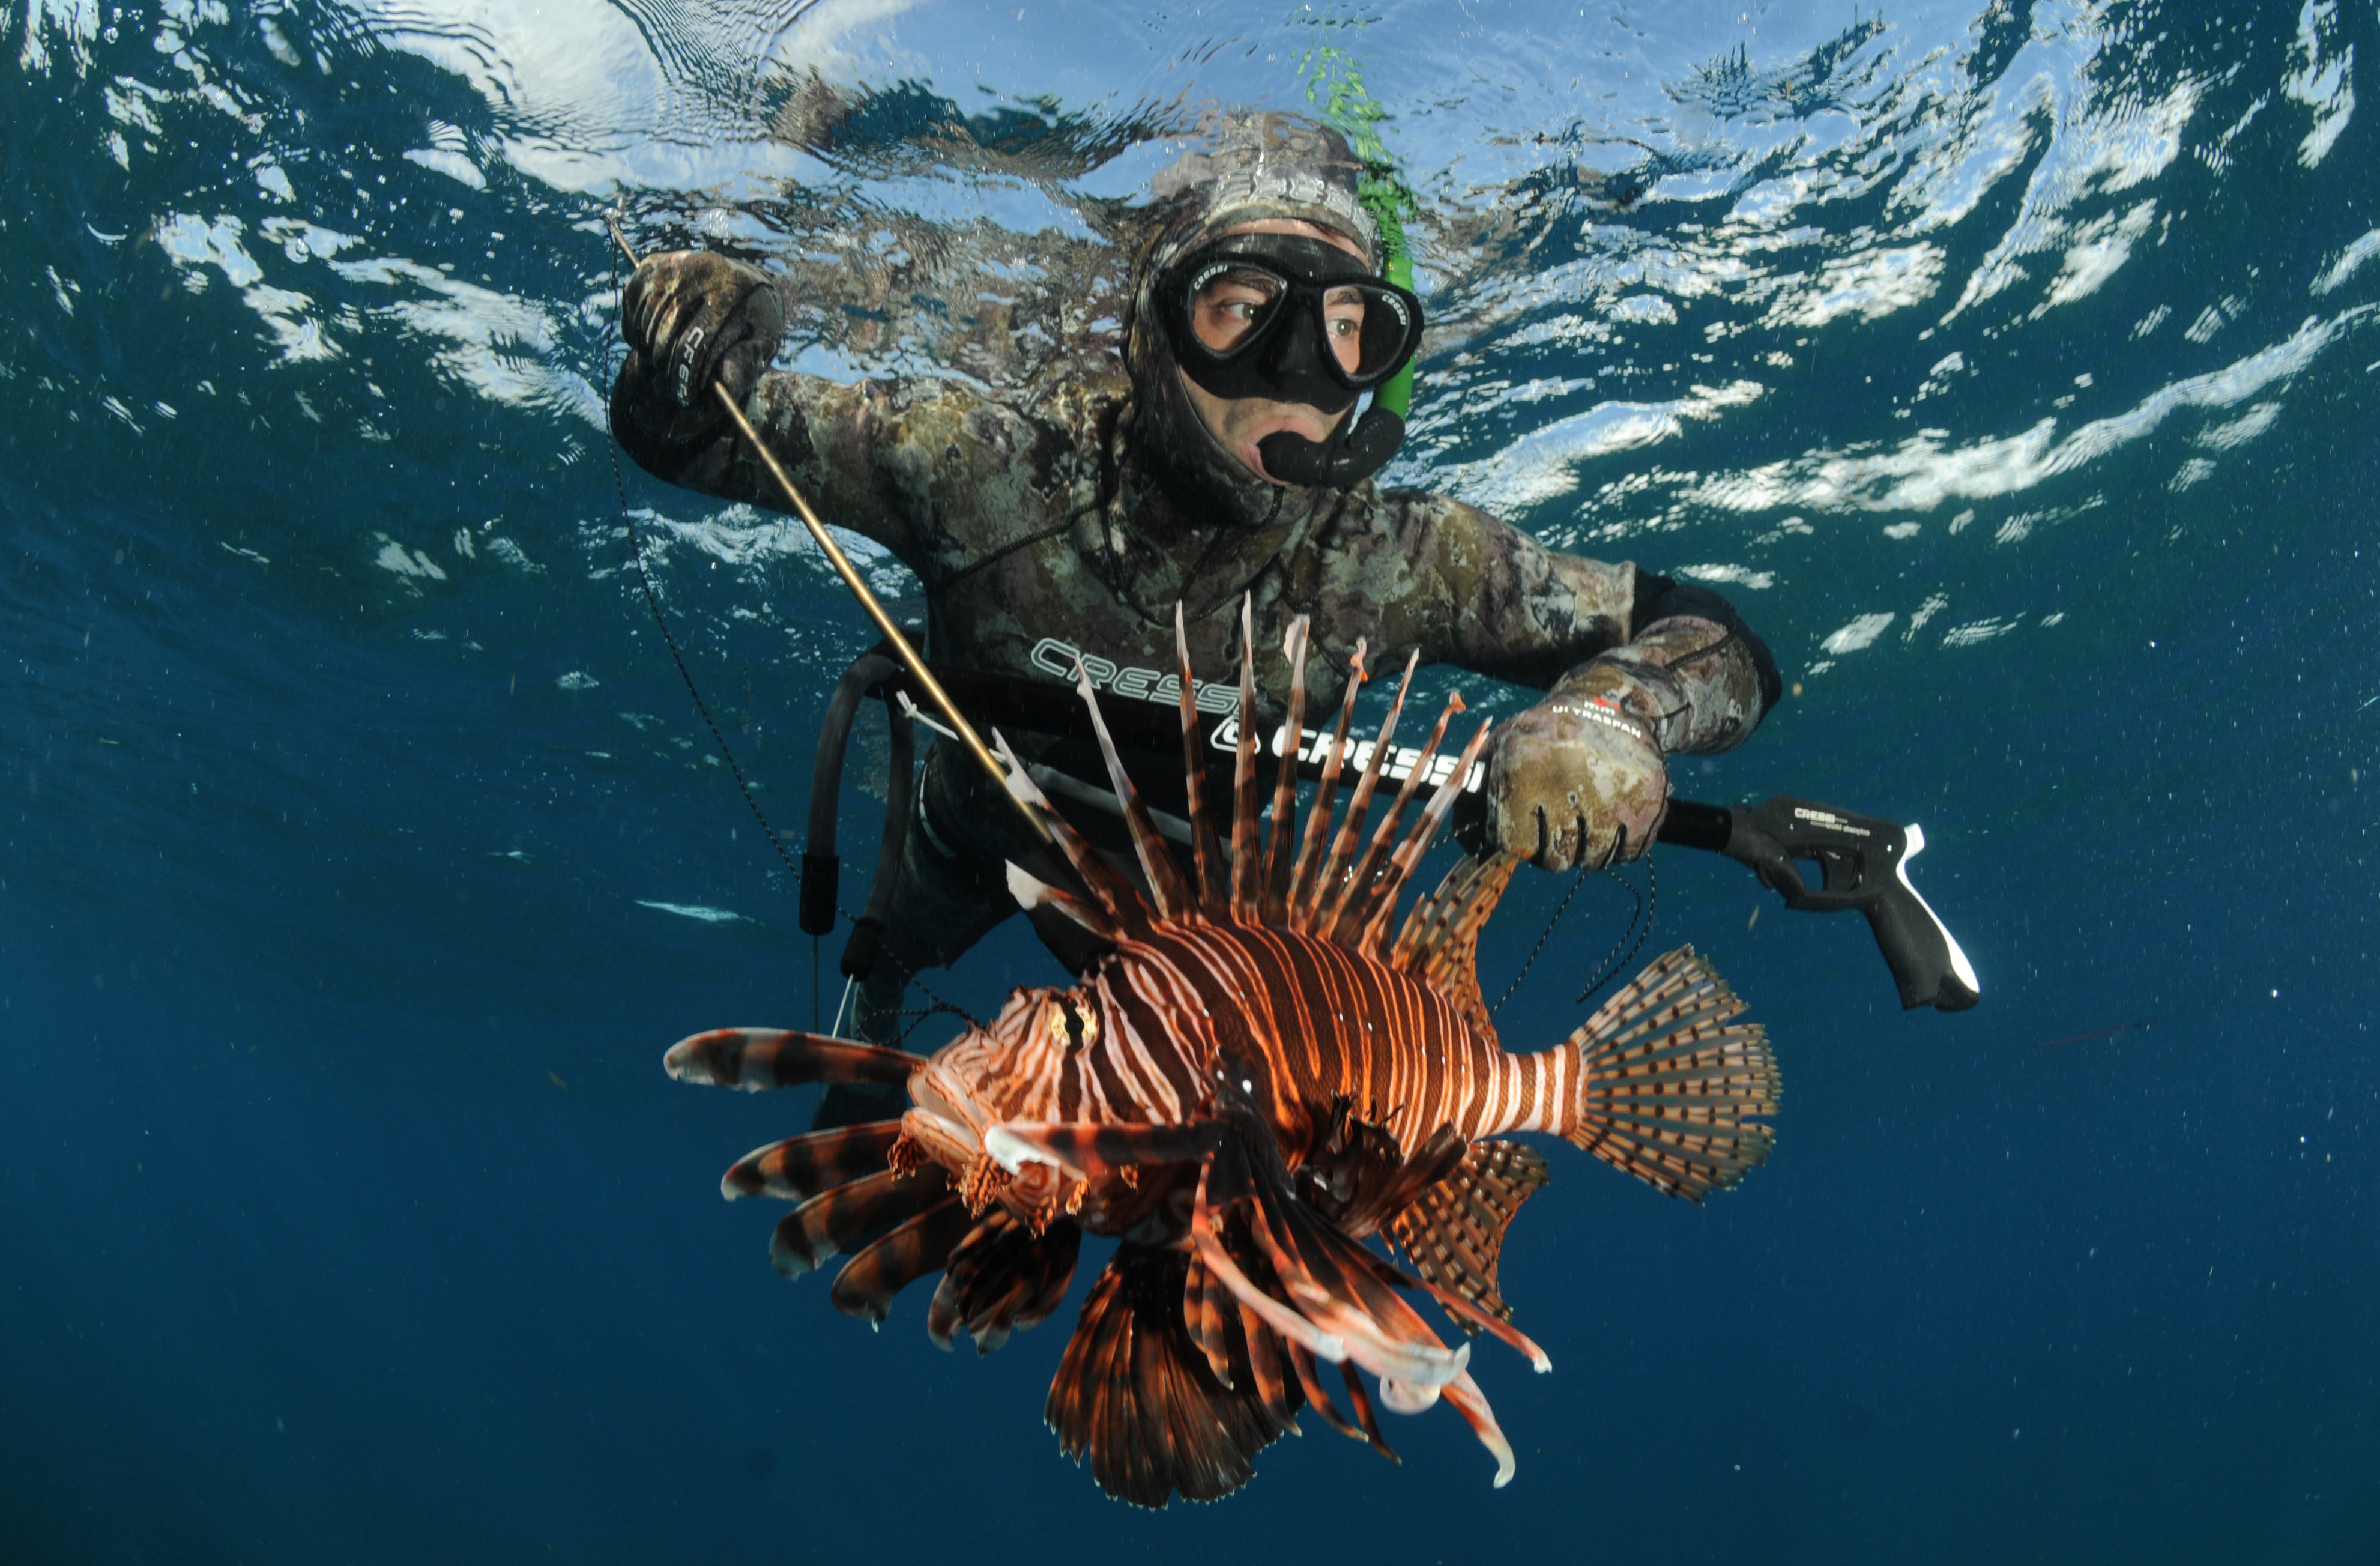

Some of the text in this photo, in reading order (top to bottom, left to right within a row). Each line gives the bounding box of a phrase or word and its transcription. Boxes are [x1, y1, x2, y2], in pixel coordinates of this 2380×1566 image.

[1194, 265, 1228, 291] CRESSI
[1382, 294, 1407, 325] CRESSI
[1031, 638, 1240, 715] CRESS
[1272, 725, 1486, 793] CRESSI
[1795, 807, 1835, 824] CRESSI
